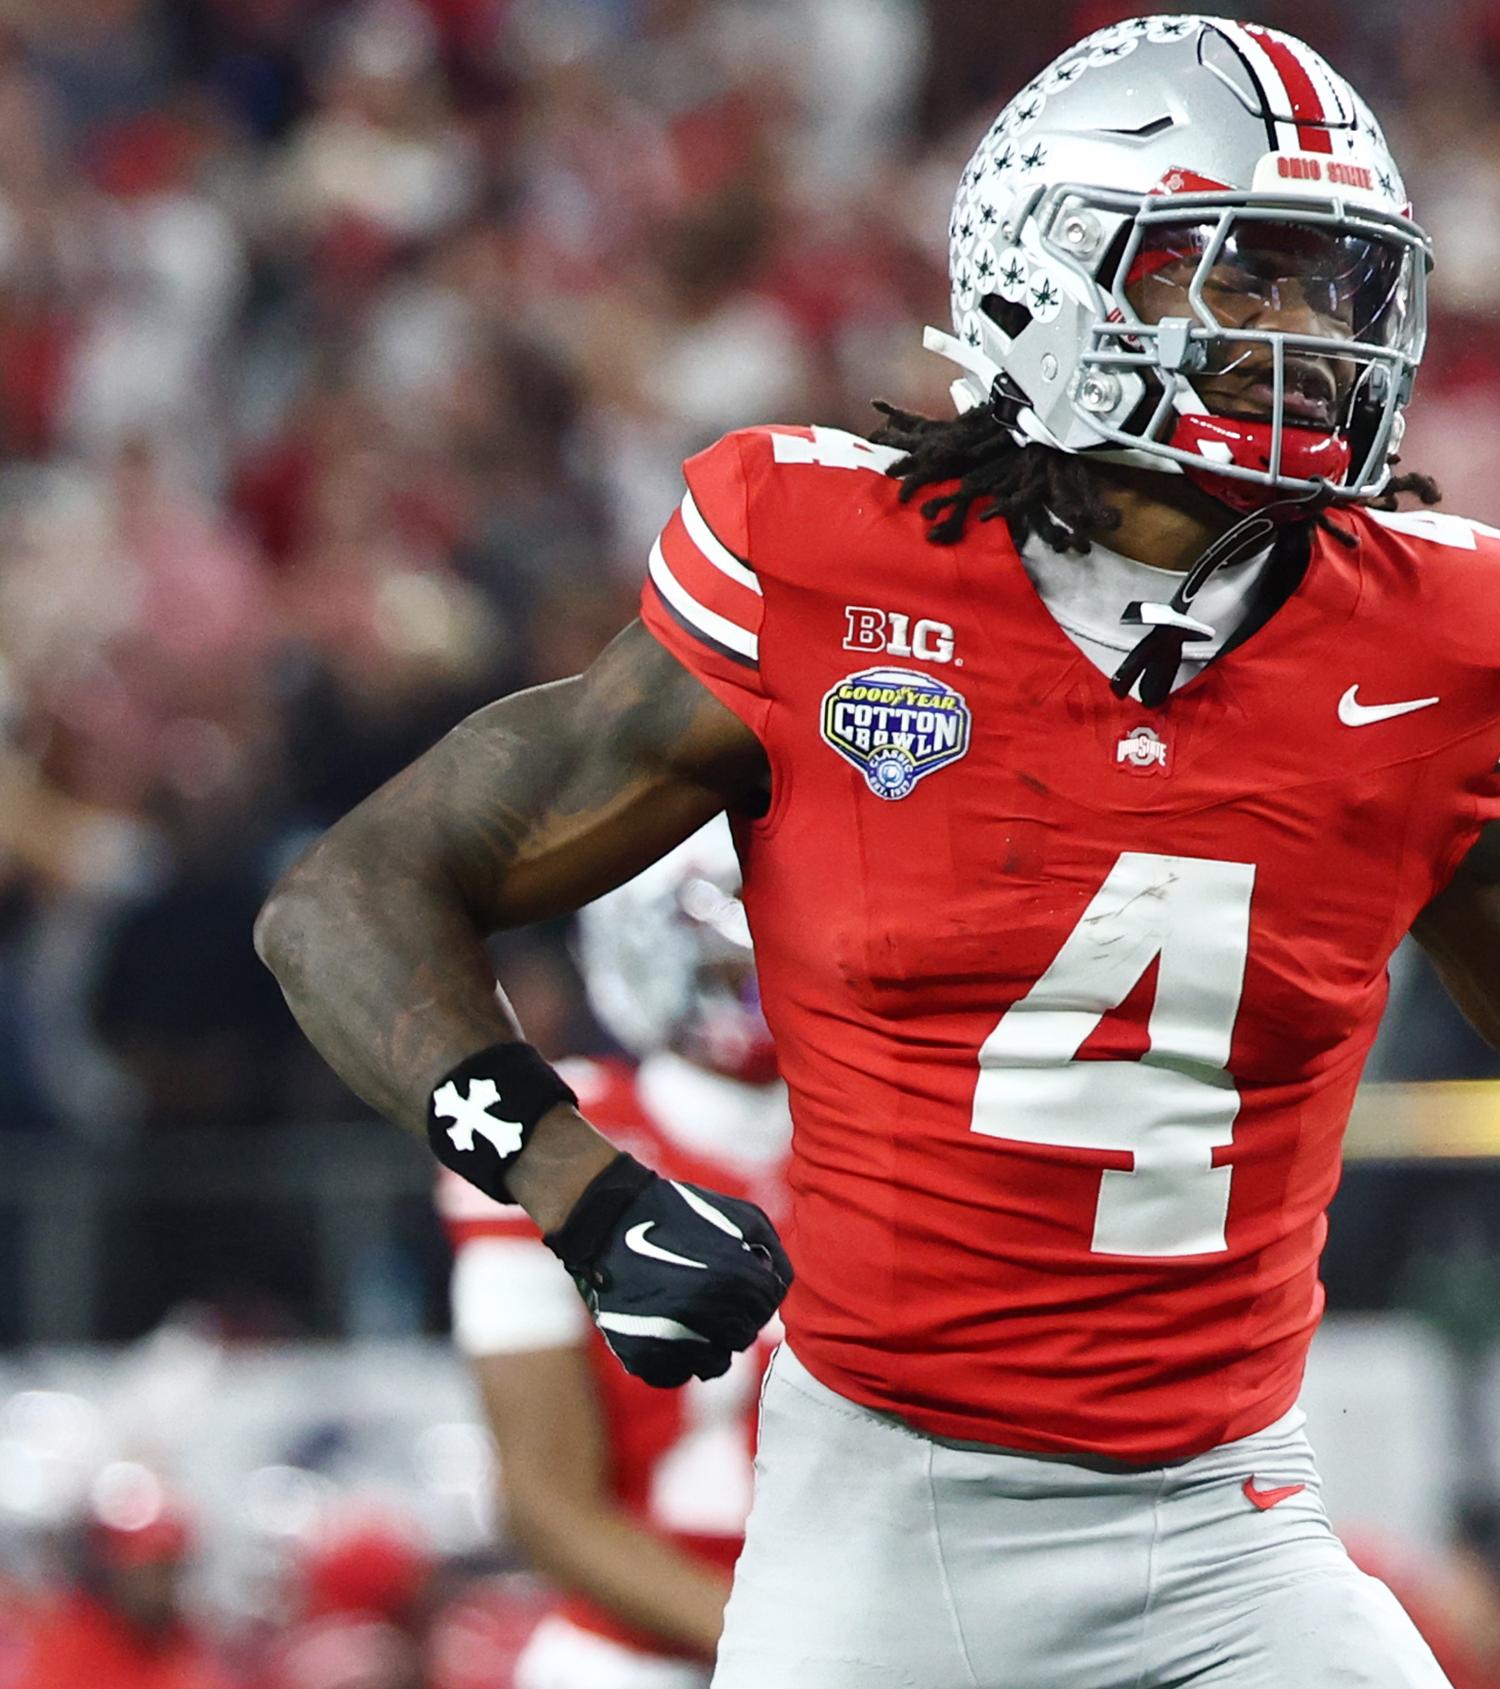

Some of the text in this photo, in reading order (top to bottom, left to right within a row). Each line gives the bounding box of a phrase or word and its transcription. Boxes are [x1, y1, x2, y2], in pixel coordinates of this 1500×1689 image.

[1277, 157, 1373, 190] OHIO STATE
[834, 702, 958, 751] COTTON
[855, 728, 932, 758] BOWL
[869, 749, 913, 773] CLASSIC
[970, 852, 1256, 1257] 4
